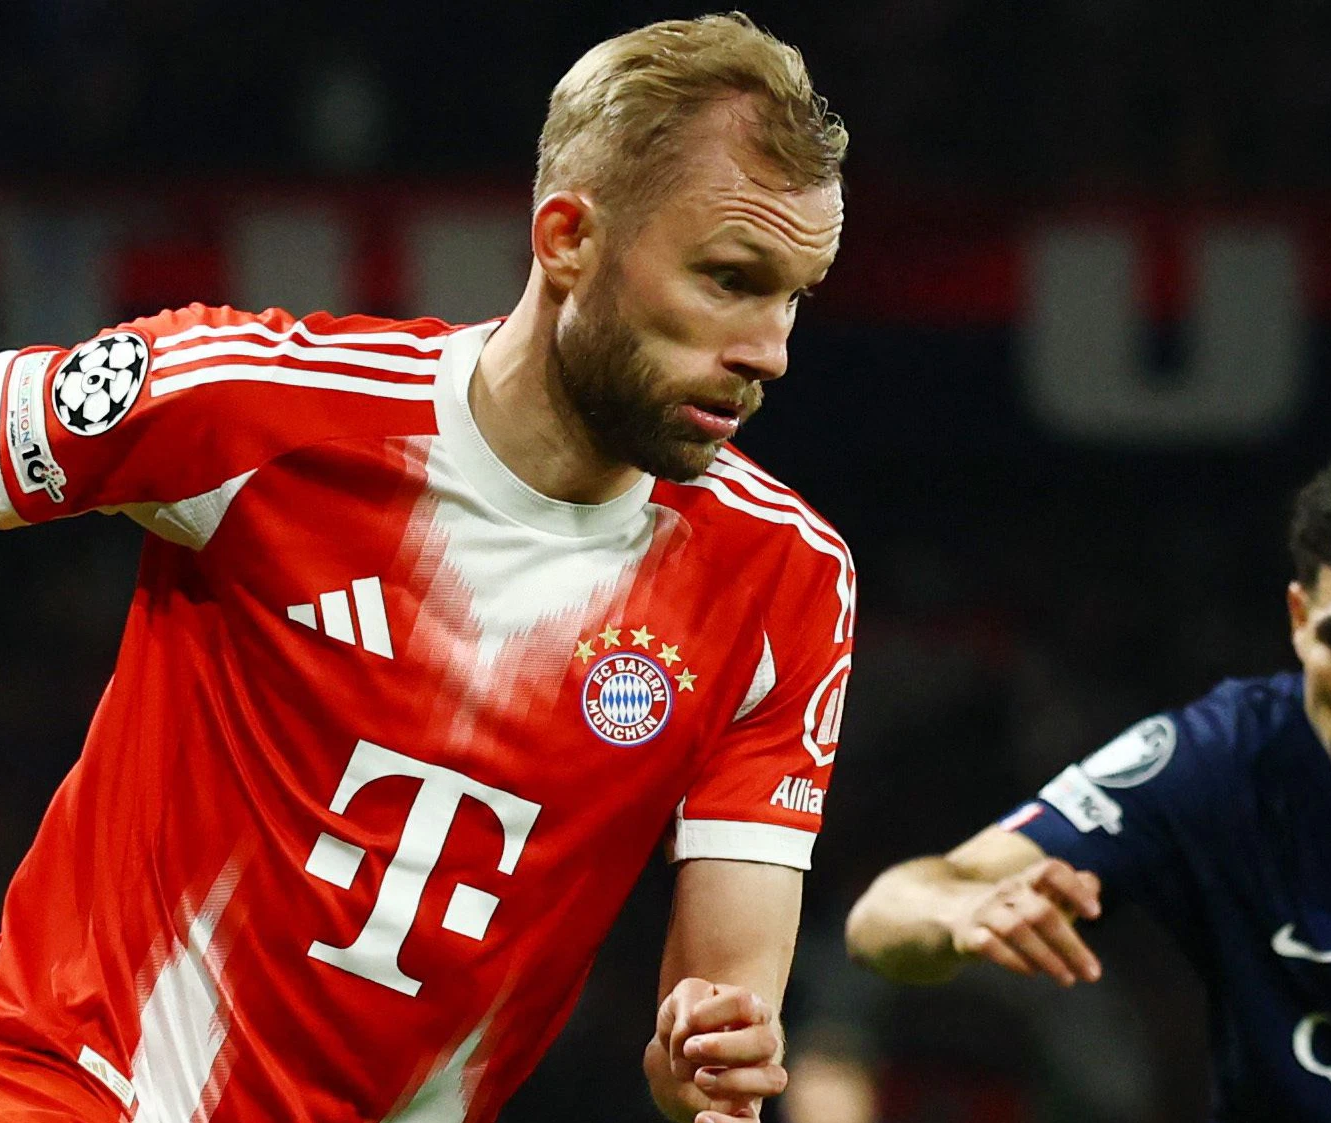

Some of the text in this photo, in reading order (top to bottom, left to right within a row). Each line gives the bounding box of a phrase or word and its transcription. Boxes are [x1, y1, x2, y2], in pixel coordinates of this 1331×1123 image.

[592, 659, 666, 702] FC BAYERN
[587, 699, 658, 740] MÜNCHEN
[769, 775, 827, 815] Allia
[304, 738, 542, 998] T
